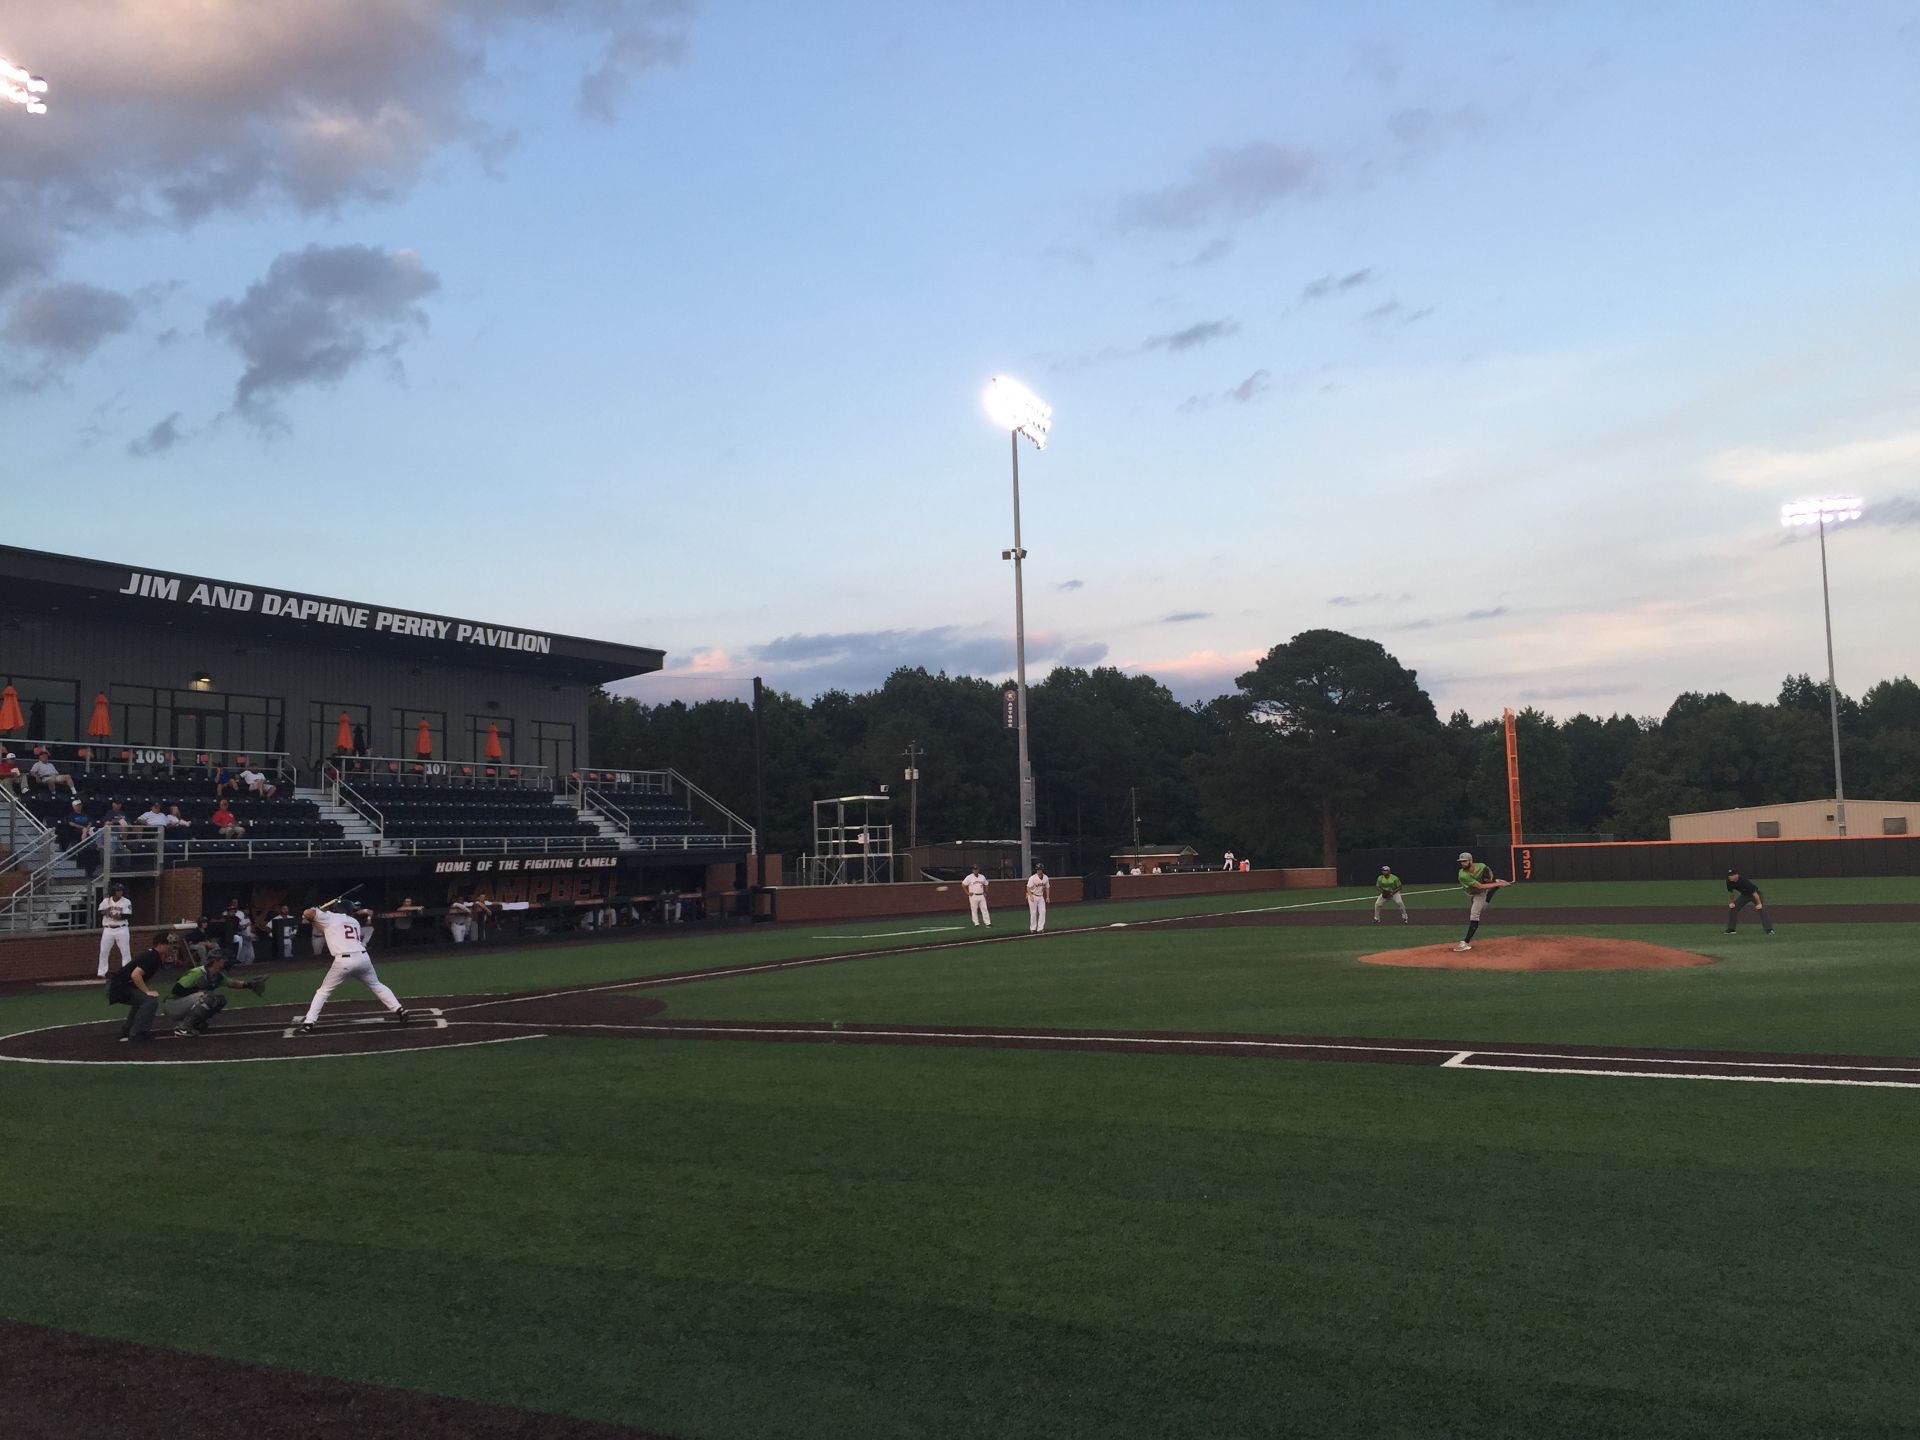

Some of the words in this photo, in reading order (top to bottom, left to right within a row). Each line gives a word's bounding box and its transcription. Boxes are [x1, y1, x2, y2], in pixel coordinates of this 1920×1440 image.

[119, 573, 182, 601] JIM
[187, 583, 254, 612] AND
[260, 593, 370, 629] DAPHNE
[375, 611, 452, 640] PERRY
[456, 623, 551, 654] PAVILION
[135, 750, 165, 764] 106
[426, 763, 447, 775] 107
[435, 861, 472, 873] HOME
[476, 860, 493, 872] OF
[498, 860, 521, 871] THE
[524, 858, 574, 870] FIGHTING
[578, 857, 618, 868] CAMELS
[1522, 849, 1531, 880] 337
[343, 924, 360, 941] 21
